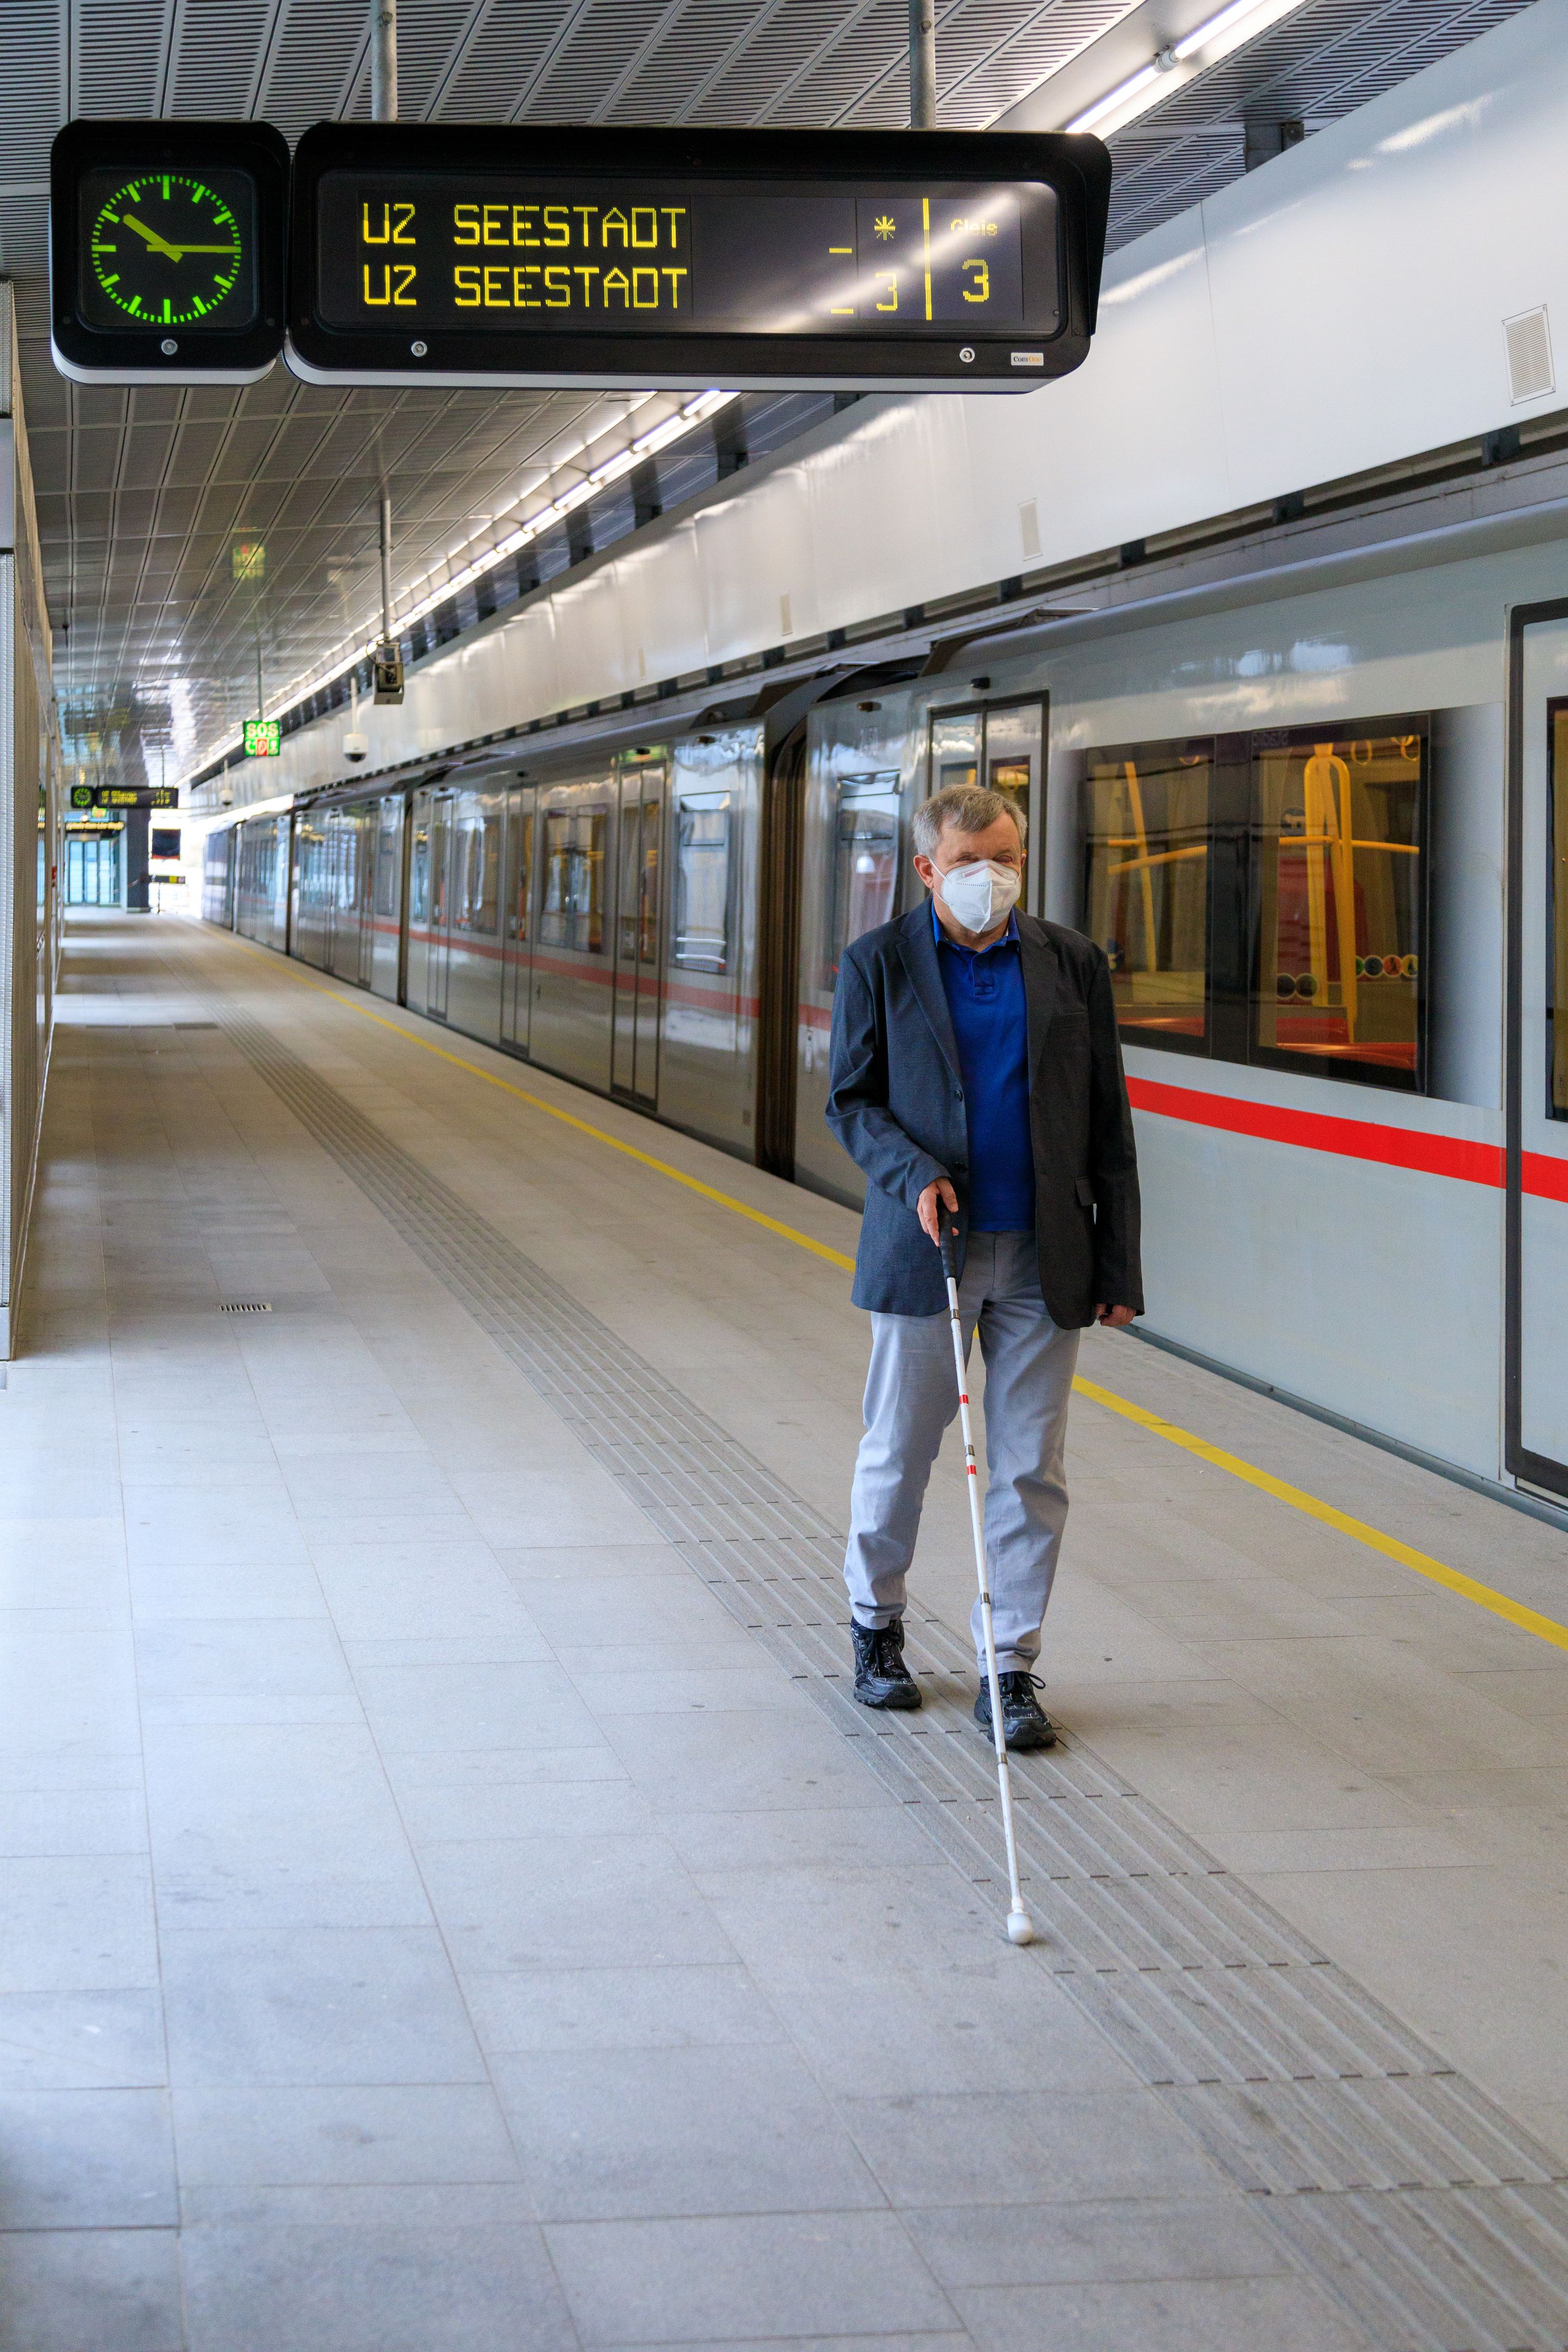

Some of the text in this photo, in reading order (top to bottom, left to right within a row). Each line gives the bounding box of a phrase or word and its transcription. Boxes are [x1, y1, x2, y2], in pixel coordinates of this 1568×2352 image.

[363, 203, 686, 248] U2 SEESTADT
[951, 219, 998, 236] Gleis
[364, 264, 687, 308] U2 SEESTADT
[875, 272, 897, 311] 3
[962, 259, 989, 302] 3
[246, 723, 279, 737] SOS
